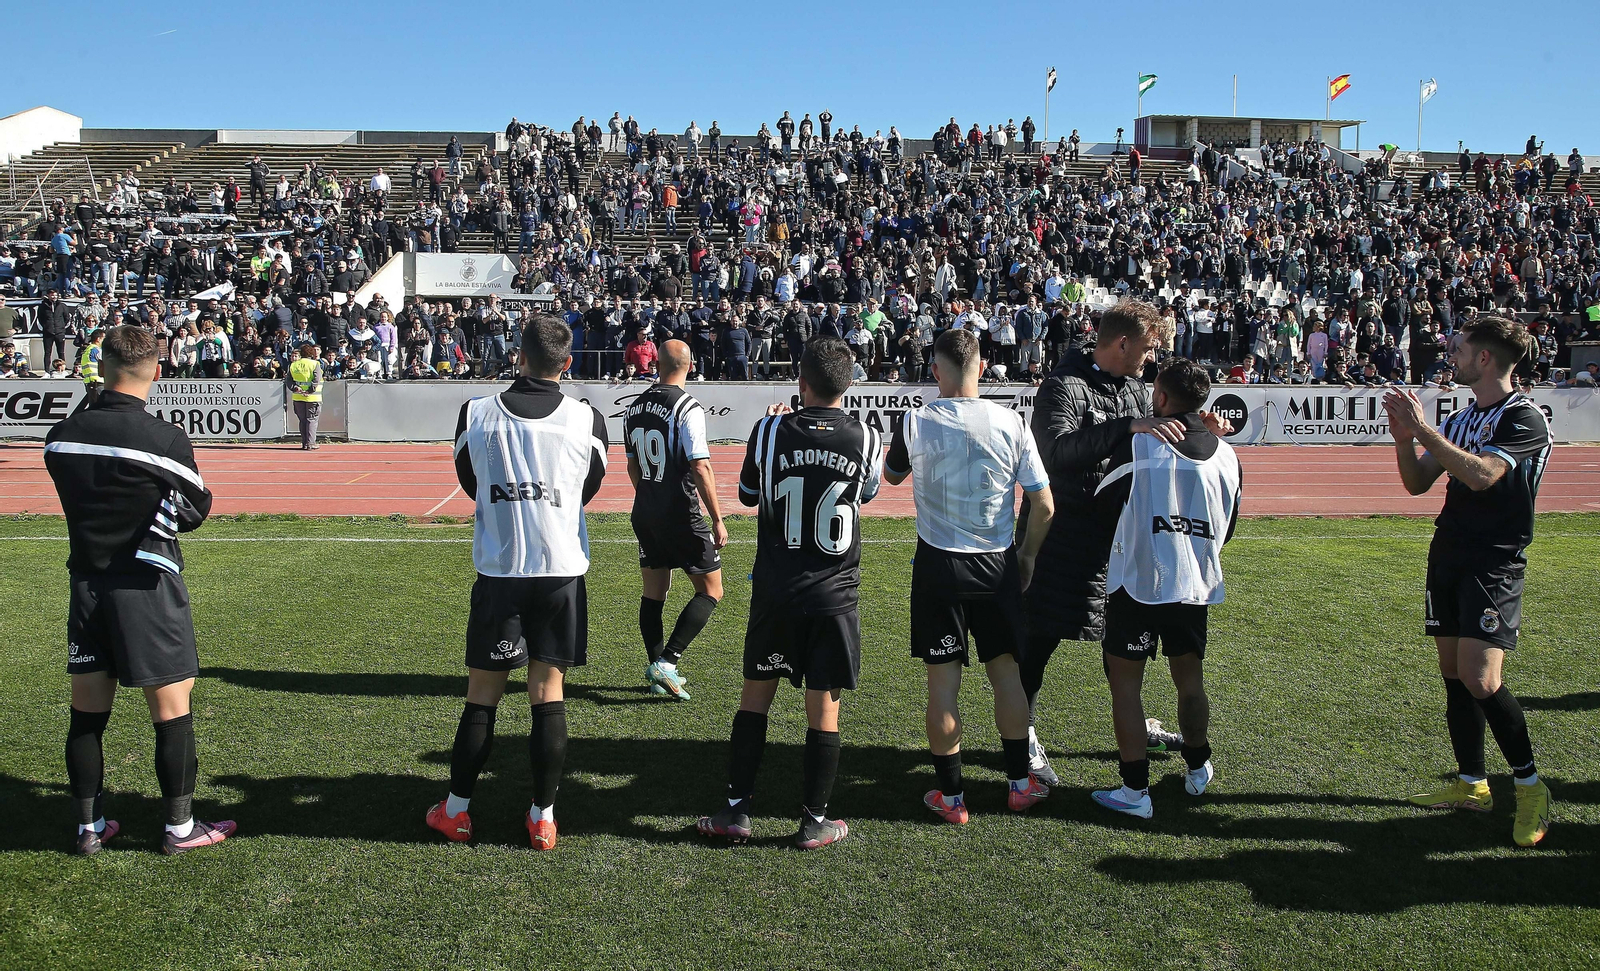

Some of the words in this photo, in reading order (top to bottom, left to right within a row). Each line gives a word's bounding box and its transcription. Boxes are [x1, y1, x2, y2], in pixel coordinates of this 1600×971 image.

[156, 383, 223, 394] MUEBLES
[228, 383, 238, 394] Y
[146, 396, 262, 406] ECTRODOMESTICOS
[841, 395, 923, 408] INTURAS
[629, 427, 668, 482] 19
[779, 449, 857, 477] A.ROMERO
[931, 458, 1003, 530] 18
[774, 476, 852, 555] 16
[930, 648, 946, 656] Ruiz
[1127, 643, 1144, 651] Ruiz
[756, 663, 773, 671] Ruiz
